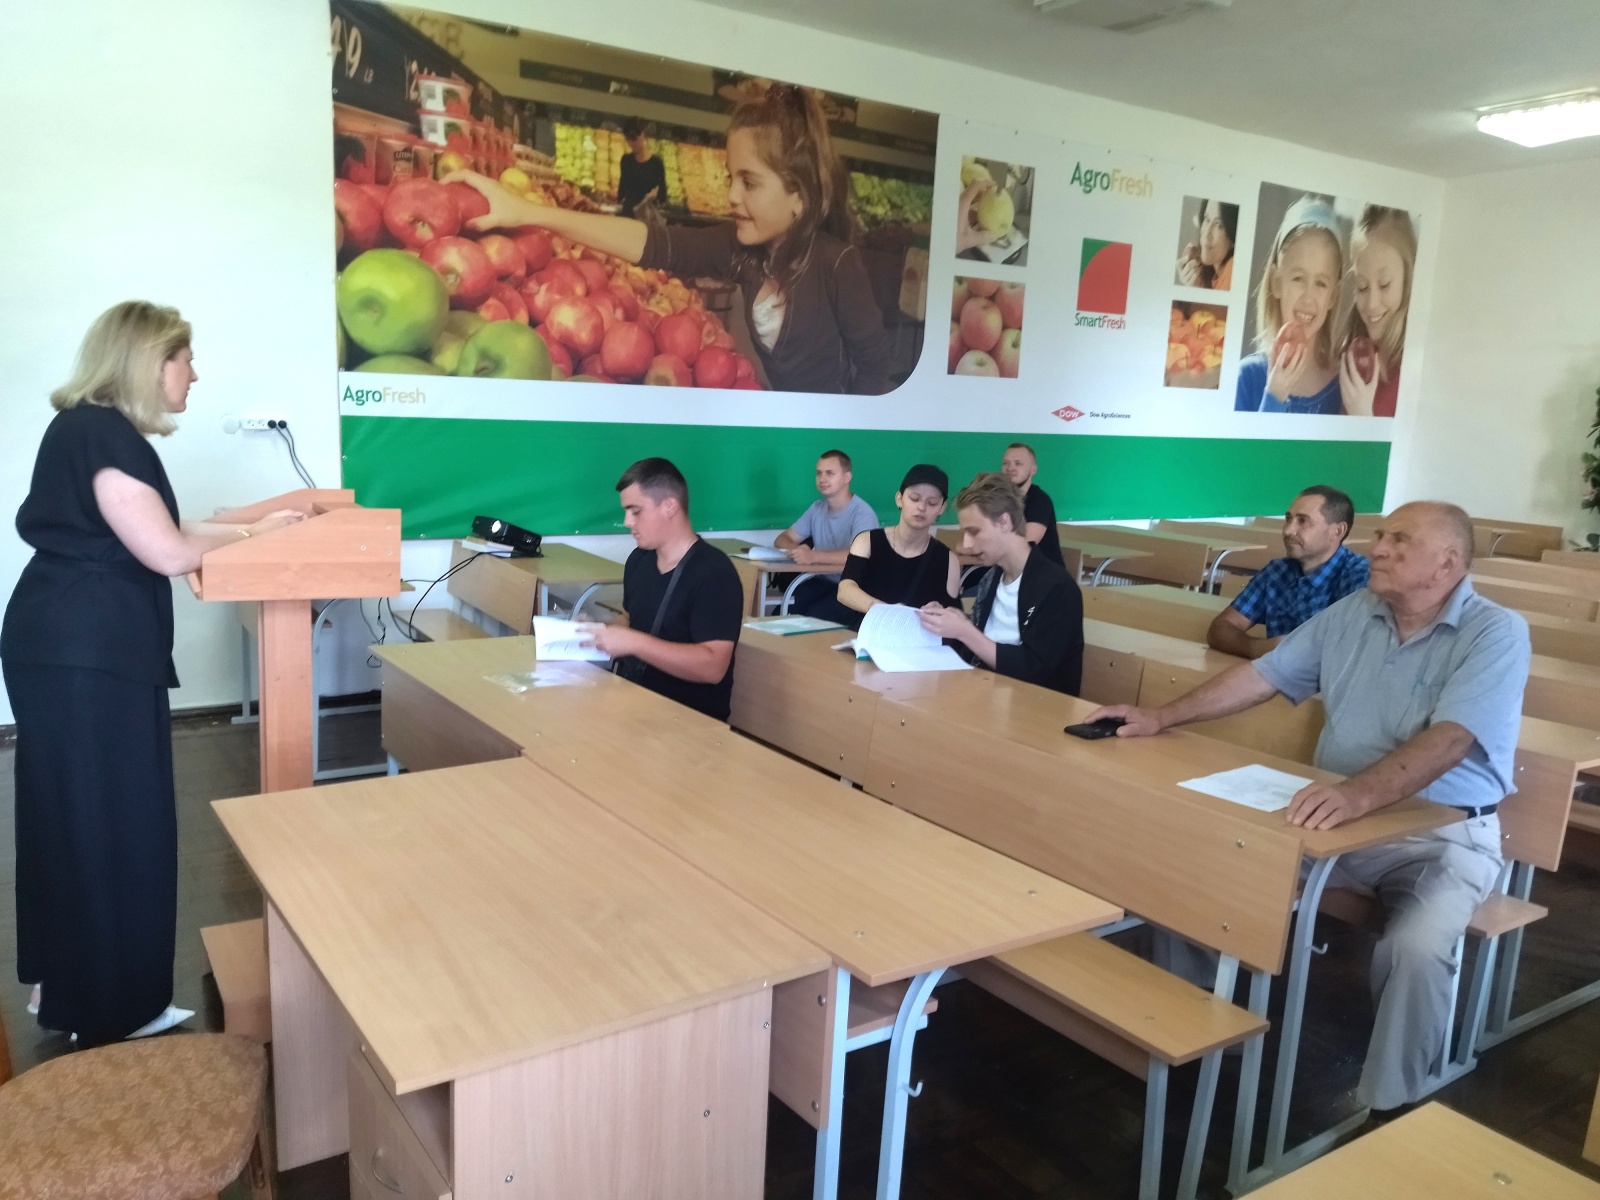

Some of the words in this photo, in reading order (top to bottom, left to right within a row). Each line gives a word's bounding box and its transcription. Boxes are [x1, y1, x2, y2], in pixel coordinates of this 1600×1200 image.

[1070, 161, 1153, 197] AgroFresh
[1074, 313, 1126, 329] SmartFresh
[343, 385, 426, 406] AgroFresh
